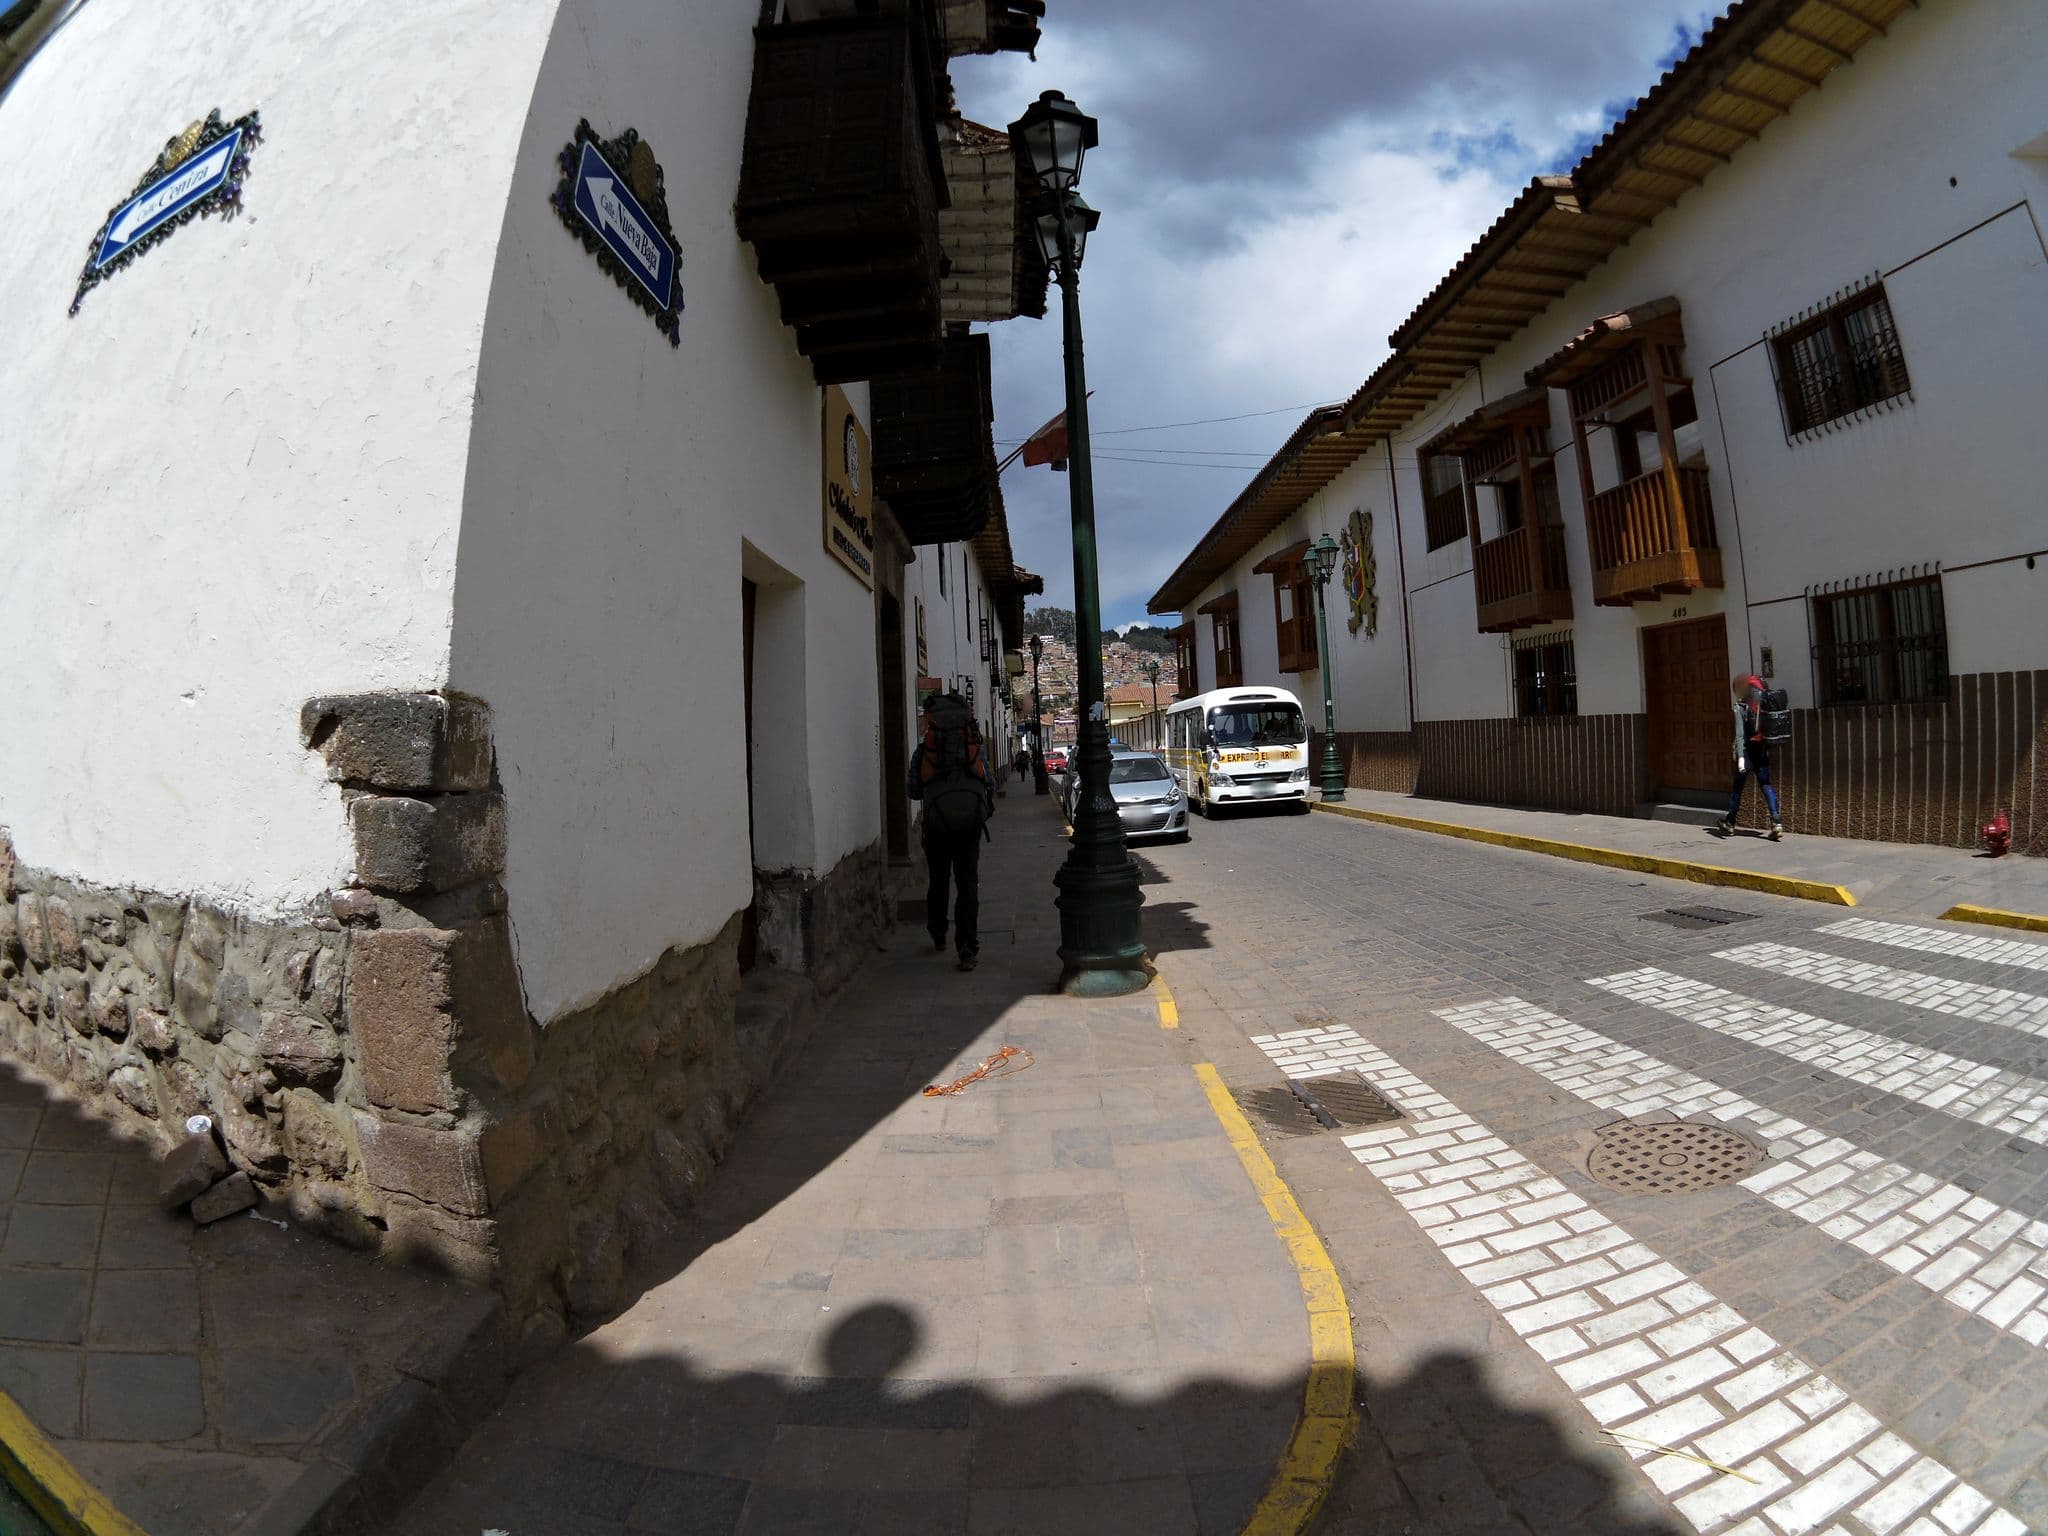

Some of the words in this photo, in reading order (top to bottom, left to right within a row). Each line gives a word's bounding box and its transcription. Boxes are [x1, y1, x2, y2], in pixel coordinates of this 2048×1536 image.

[158, 166, 208, 207] Ceniza
[600, 194, 615, 219] Calle
[614, 202, 641, 250] Nueva
[640, 233, 657, 271] Baja
